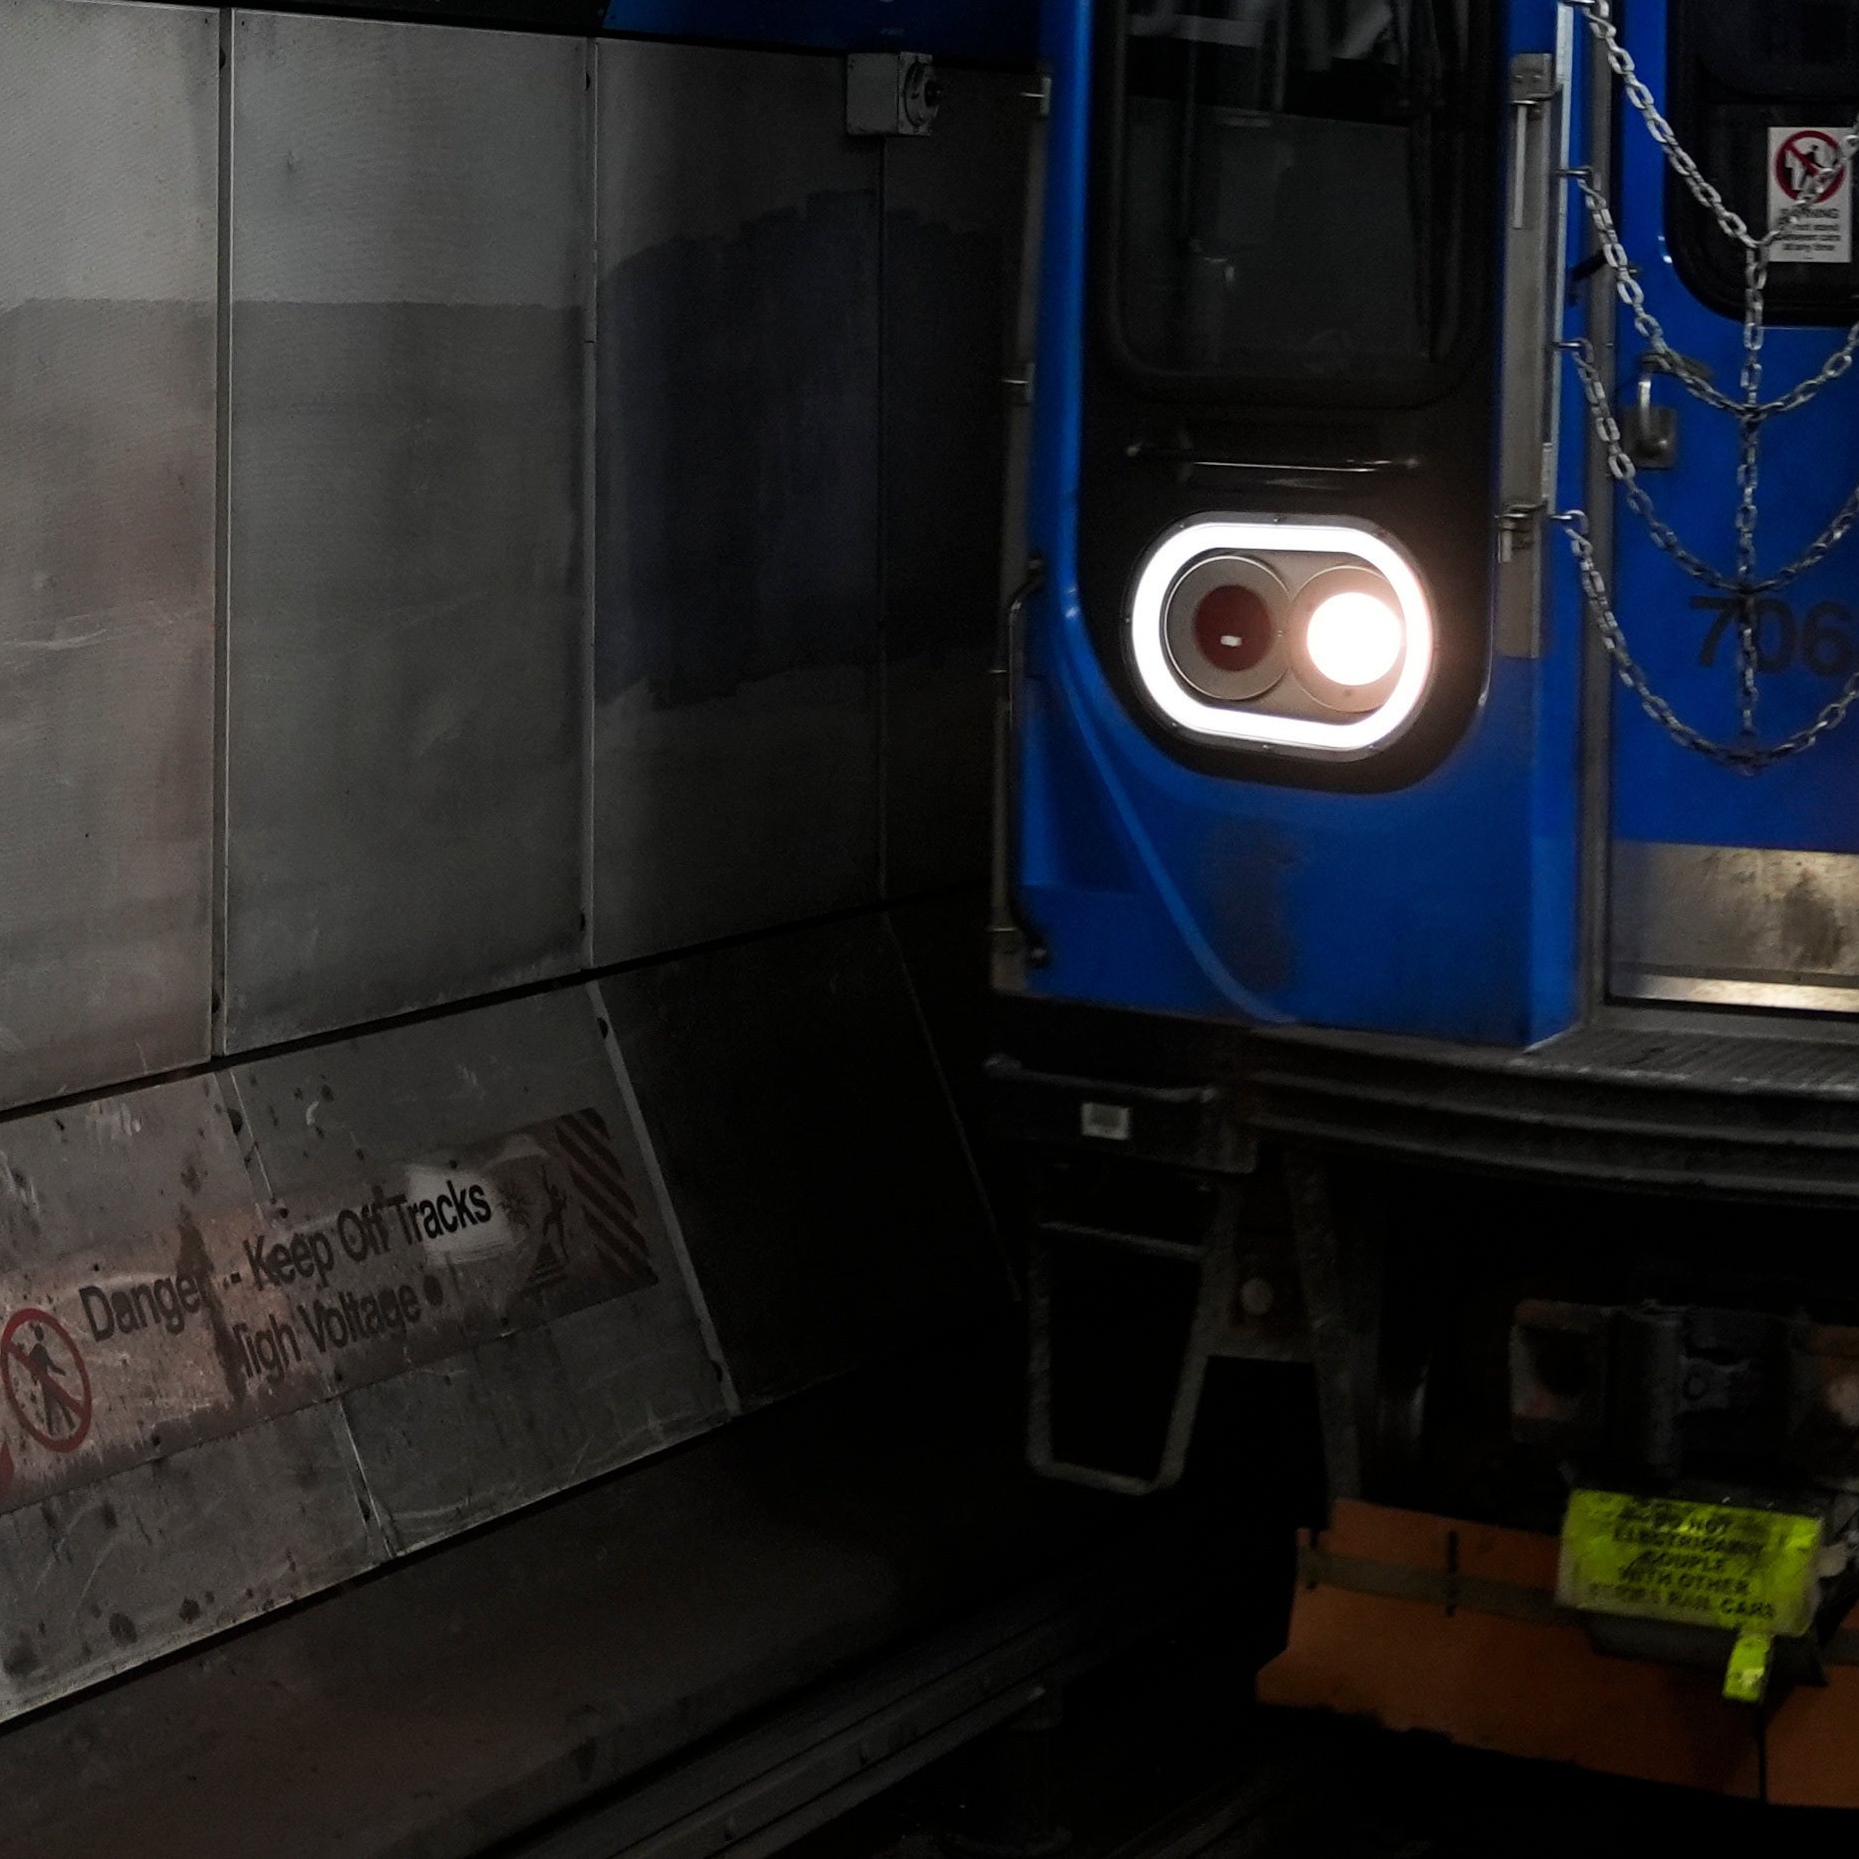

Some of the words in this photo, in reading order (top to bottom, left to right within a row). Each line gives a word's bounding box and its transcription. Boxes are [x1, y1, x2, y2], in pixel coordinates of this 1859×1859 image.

[243, 1232, 334, 1292] Keep
[385, 1180, 492, 1246] Tracks
[297, 1283, 422, 1353] Voltage
